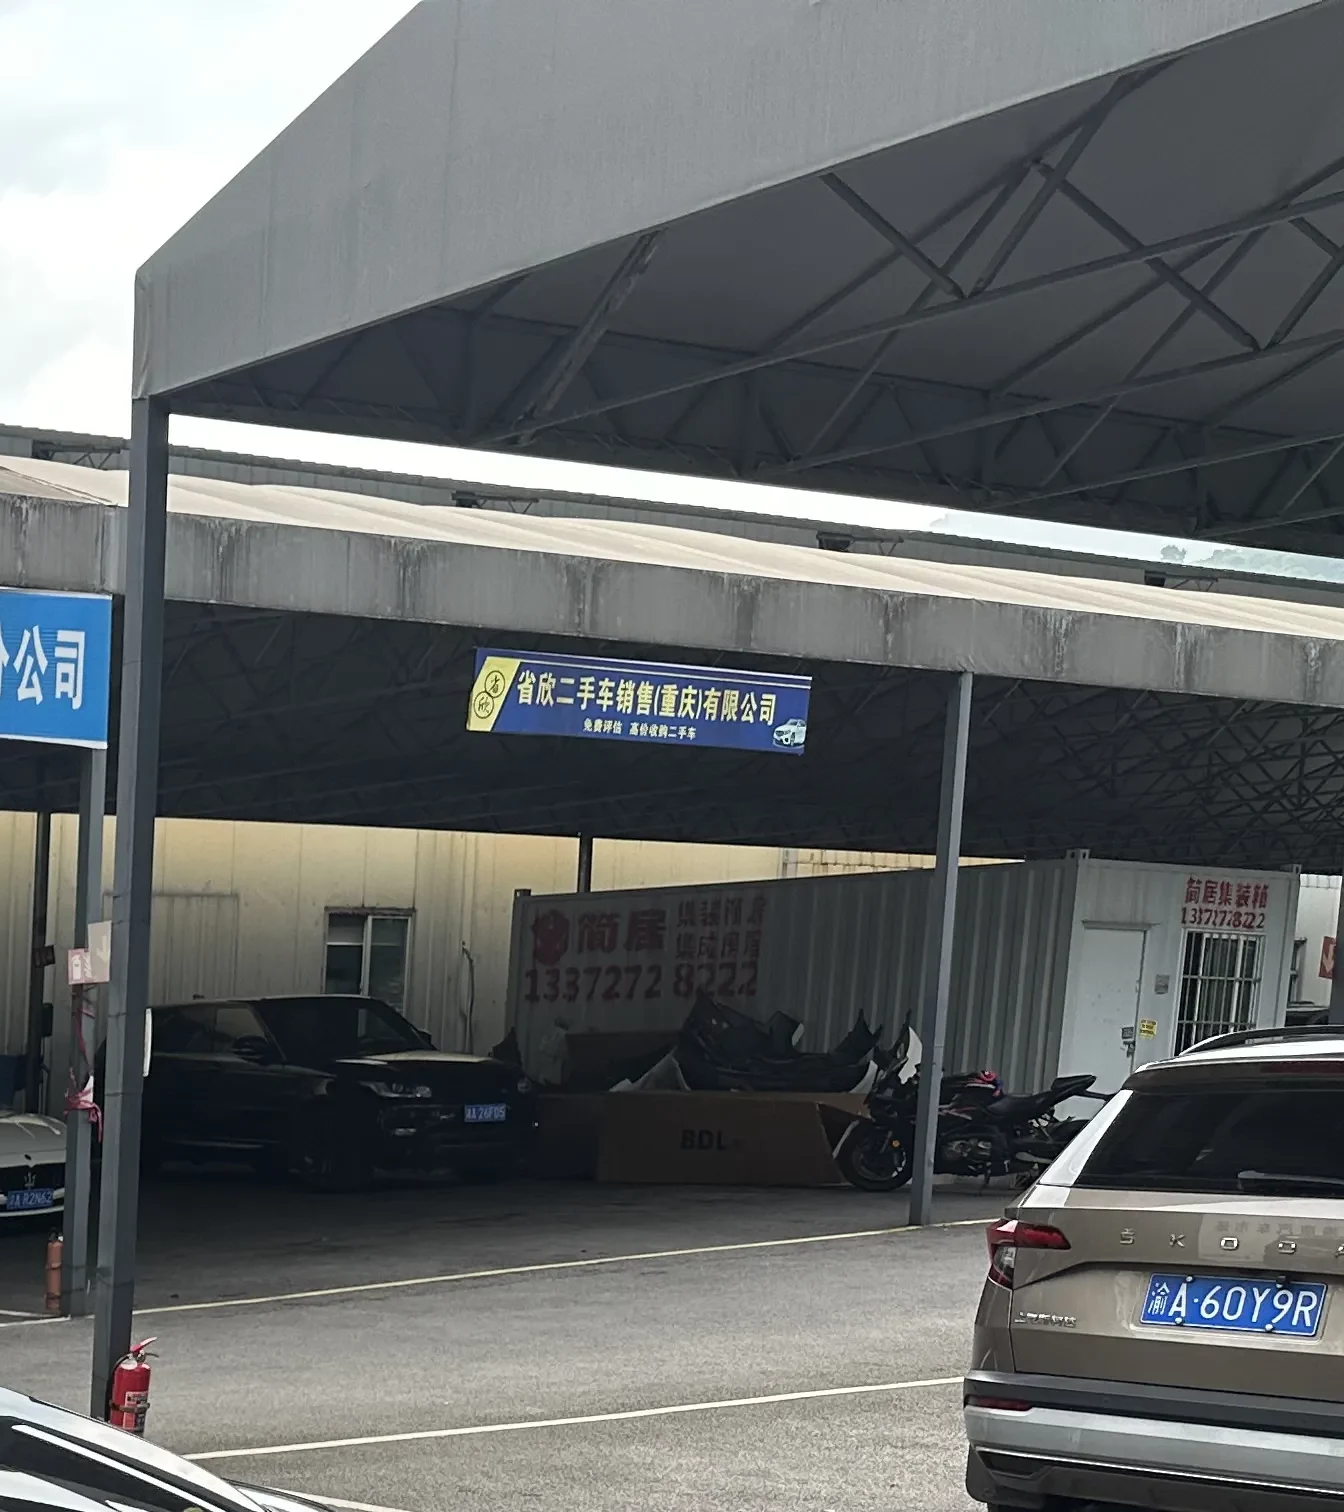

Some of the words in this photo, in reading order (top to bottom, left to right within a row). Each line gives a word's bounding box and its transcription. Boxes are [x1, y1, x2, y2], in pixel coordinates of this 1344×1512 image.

[517, 670, 777, 727] 省欣二手车销售(重庆)有限公司
[583, 718, 624, 735] 免费评估
[579, 909, 666, 954] 简居
